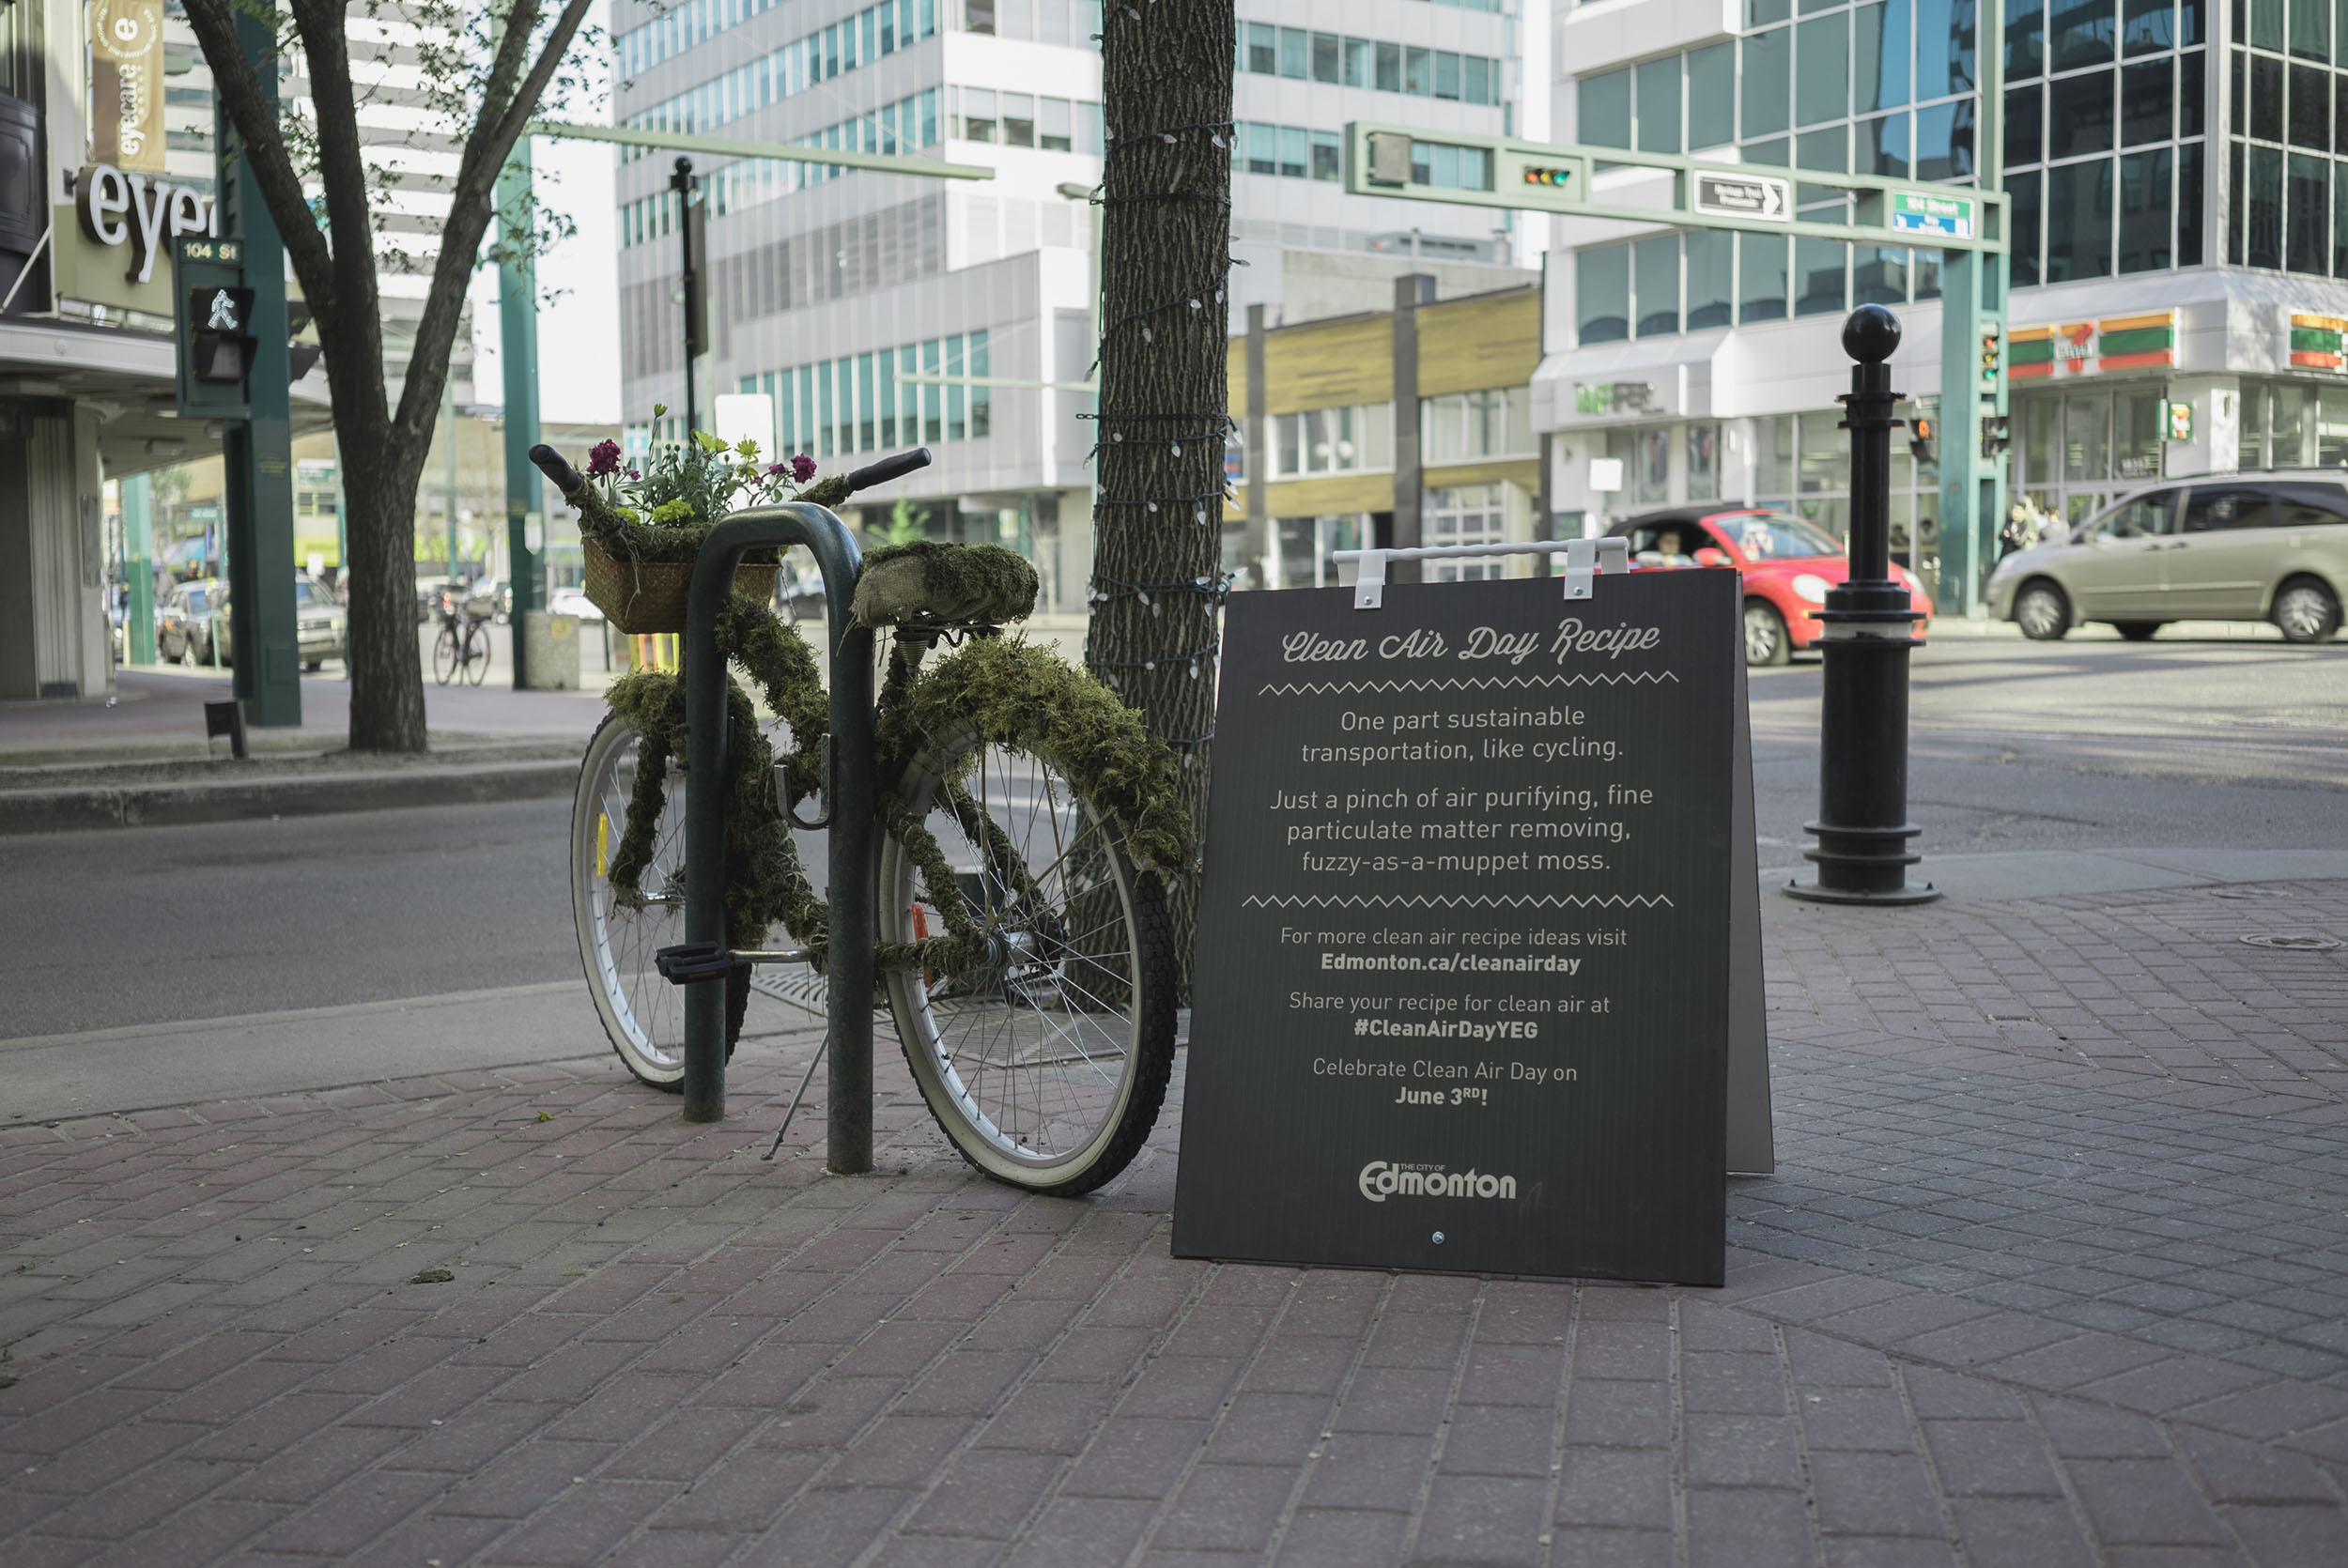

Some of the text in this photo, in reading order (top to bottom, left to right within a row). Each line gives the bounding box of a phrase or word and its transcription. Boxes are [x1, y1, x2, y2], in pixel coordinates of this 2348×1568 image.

[118, 63, 147, 156] eyecare
[184, 242, 237, 260] 104 St
[1281, 617, 1661, 666] Clean Air Day Recipe
[1341, 705, 1585, 736] One part sustainable
[1301, 735, 1624, 767] transportation, like cycling.
[1269, 783, 1653, 815] Just a pinch of air purifying, fine
[1287, 816, 1630, 846] particulate matter removing,
[1302, 851, 1611, 877] fuzzy-as-a-muppet moss.
[1280, 927, 1628, 950] For more clean air recipe ideas visit
[1321, 952, 1582, 976] Edmonton.ca/cleanairday
[1289, 991, 1611, 1016] Share your recipe for clean air at
[1353, 1018, 1538, 1042] #CleanAirDayYEG
[1313, 1057, 1578, 1085] Celebrate Clean Air Day on
[1394, 1085, 1445, 1105] June
[1399, 1162, 1446, 1172] THE CITY OF
[1358, 1160, 1517, 1203] Edmonton
